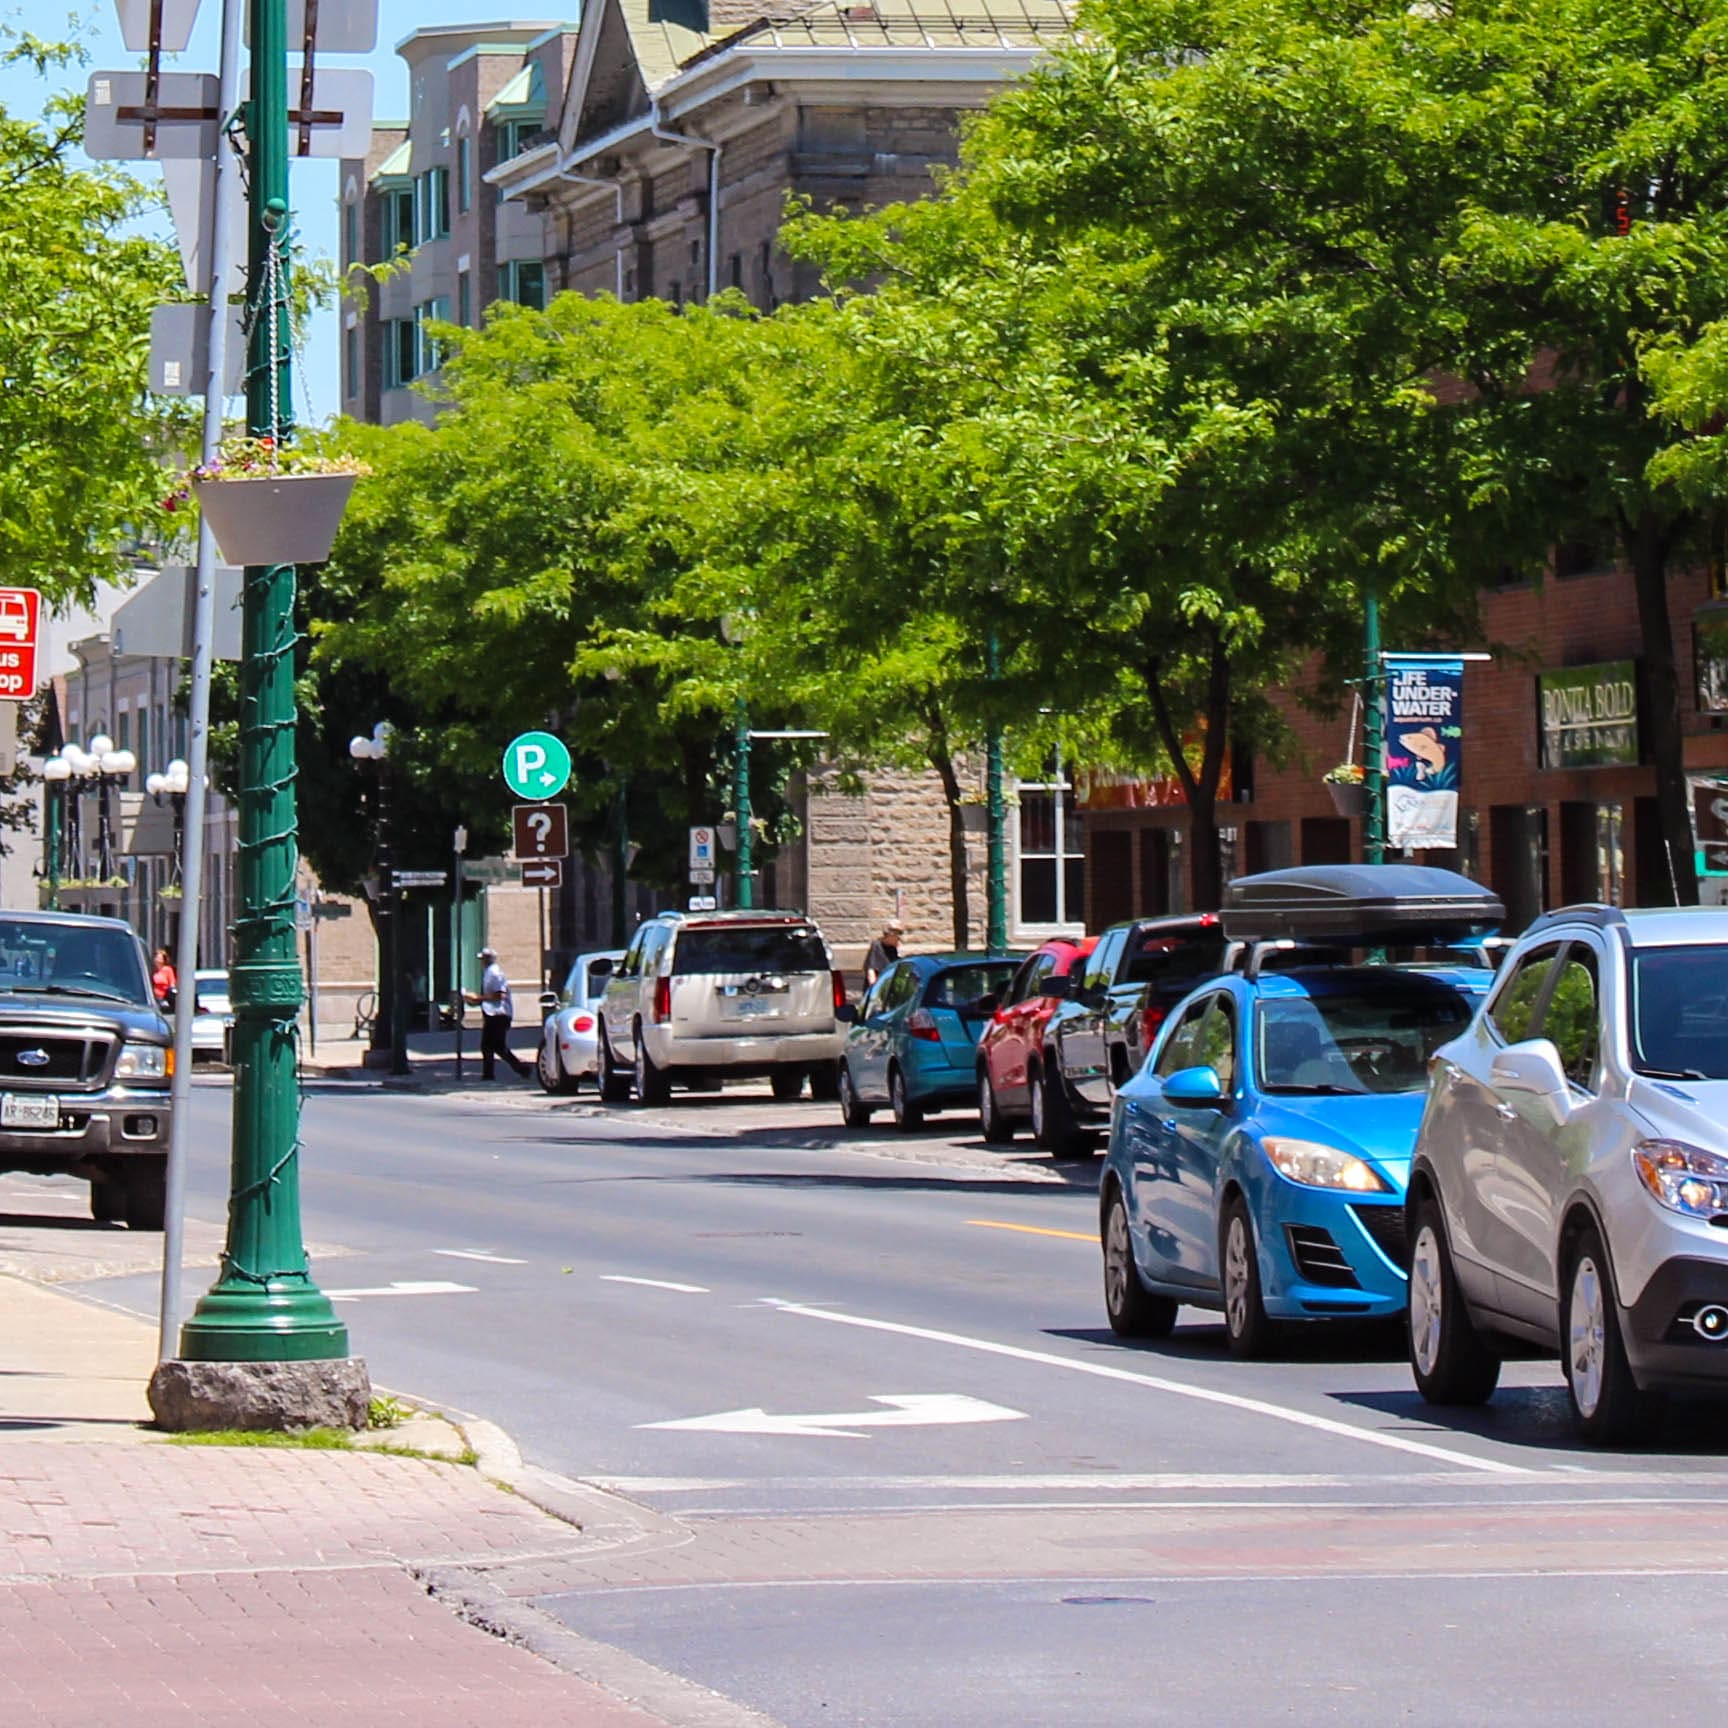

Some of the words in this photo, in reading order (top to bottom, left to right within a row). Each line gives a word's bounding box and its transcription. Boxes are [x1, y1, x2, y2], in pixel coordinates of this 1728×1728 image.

[1393, 671, 1428, 686] LIFE
[1392, 686, 1459, 702] UNDER-
[1391, 700, 1453, 717] WATER
[516, 745, 547, 783] P
